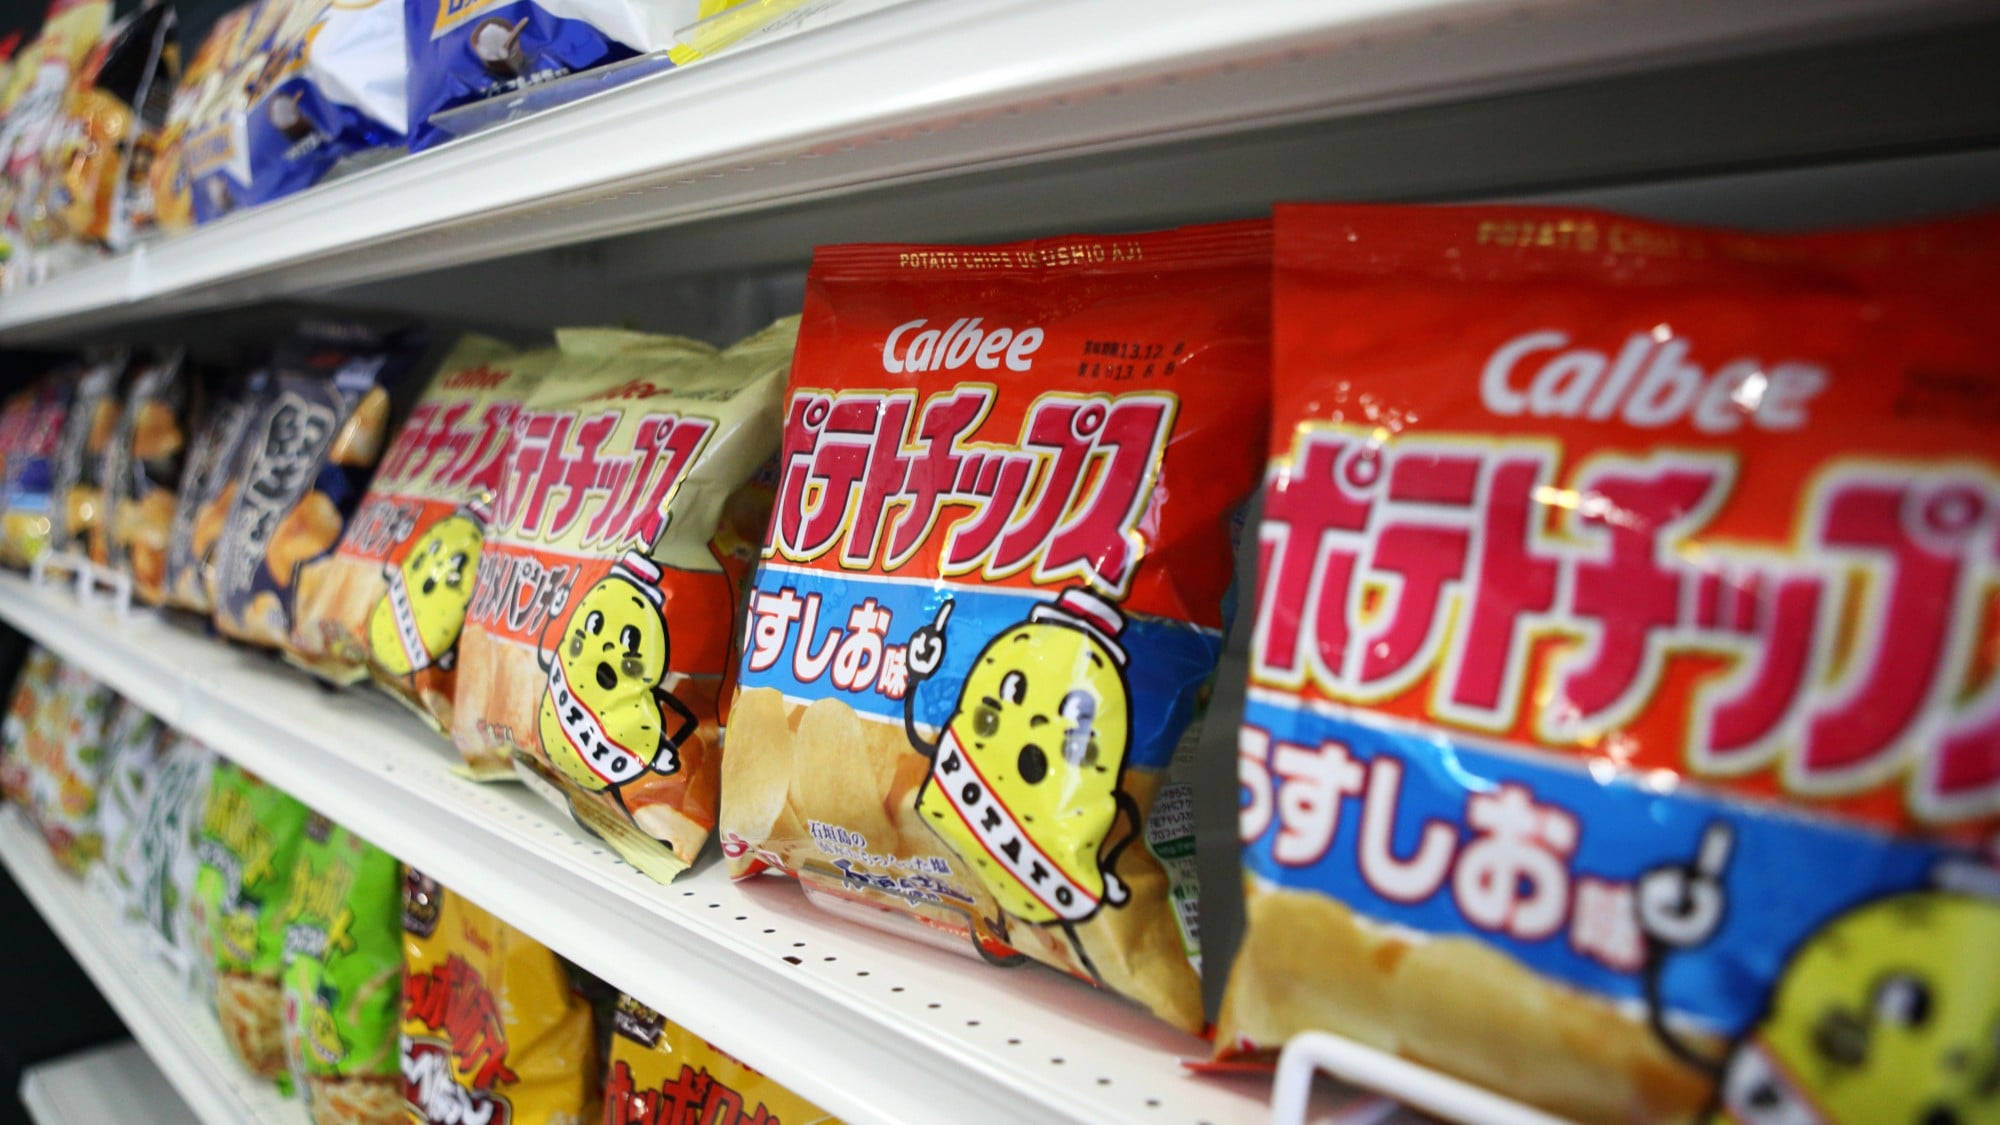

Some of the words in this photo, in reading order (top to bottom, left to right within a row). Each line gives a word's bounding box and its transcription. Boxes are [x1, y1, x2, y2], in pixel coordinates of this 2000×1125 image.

[899, 252, 958, 269] POTATO
[963, 252, 1013, 268] CHIPS
[1111, 242, 1143, 261] AJI
[883, 317, 1045, 374] Calbee
[1480, 328, 1830, 434] Calbee
[765, 385, 1178, 596] ポテトチップス
[551, 670, 629, 774] POTATO
[940, 748, 1074, 908] POTATO
